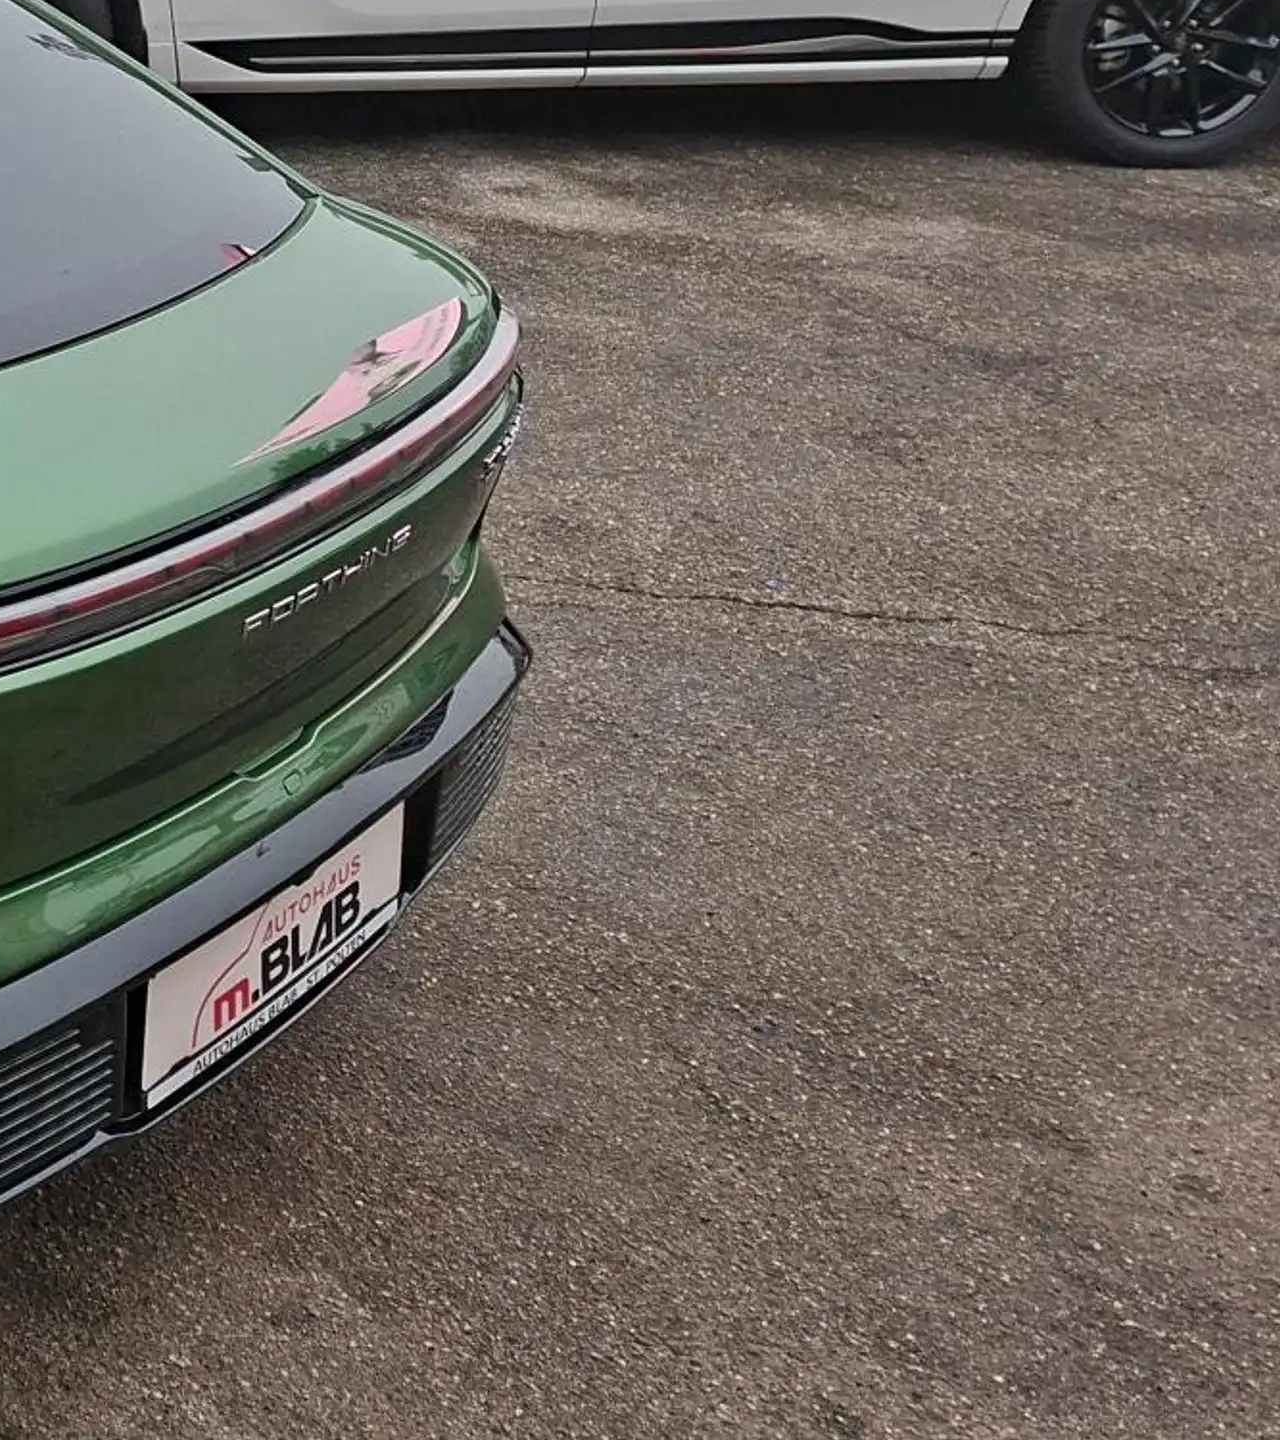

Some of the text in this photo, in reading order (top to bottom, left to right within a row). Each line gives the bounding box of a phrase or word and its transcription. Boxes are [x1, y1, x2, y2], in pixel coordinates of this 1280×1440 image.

[262, 854, 362, 944] AUTOHAUS
[213, 880, 361, 1032] m.BLAB
[193, 1012, 266, 1076] AUTOHAUS
